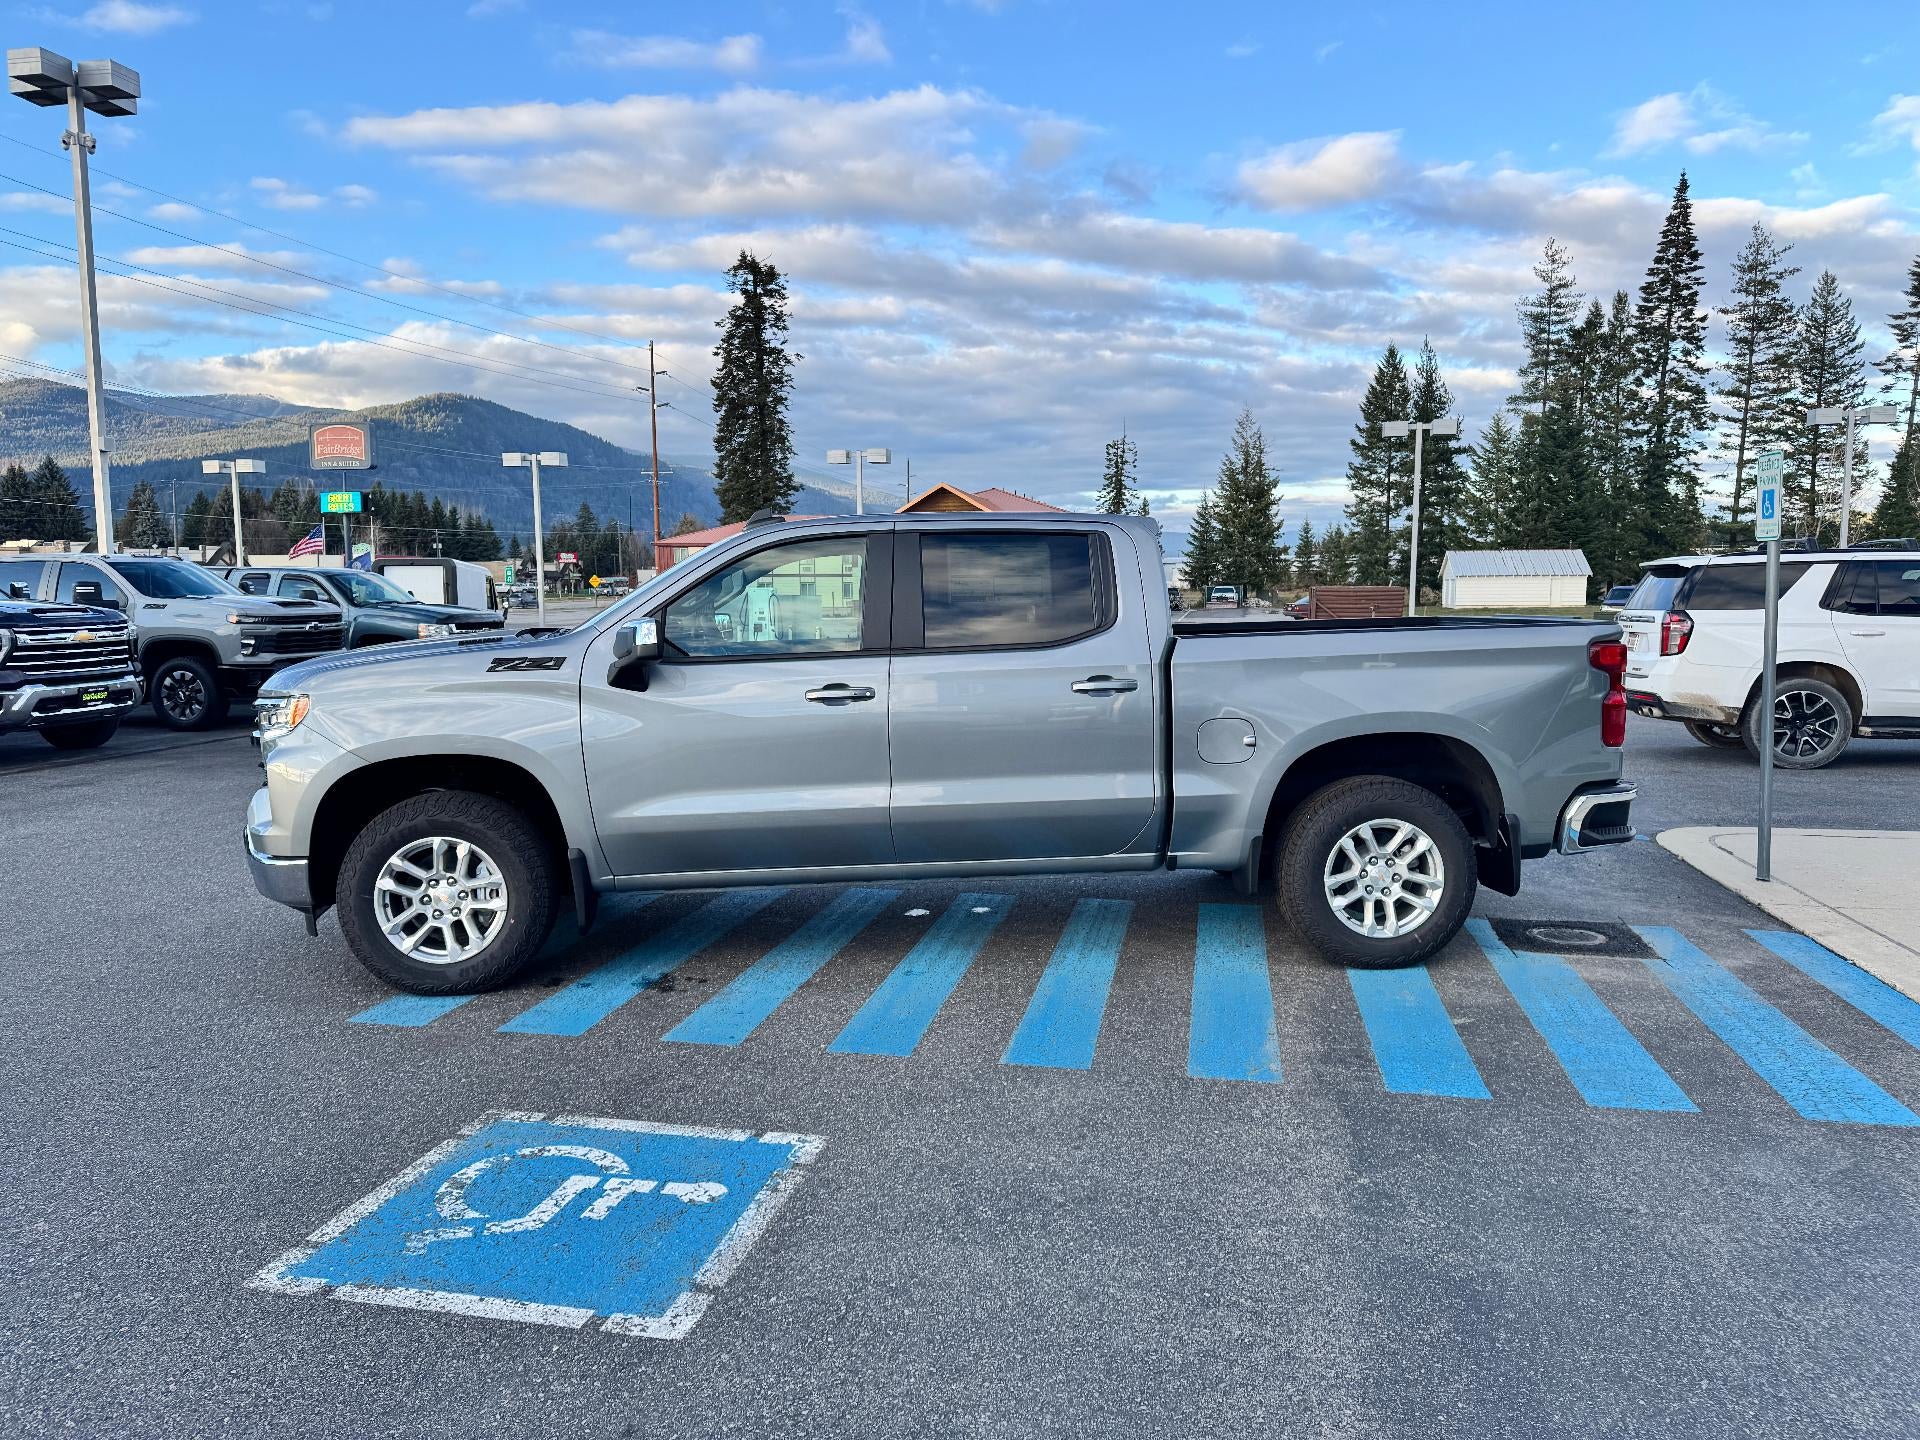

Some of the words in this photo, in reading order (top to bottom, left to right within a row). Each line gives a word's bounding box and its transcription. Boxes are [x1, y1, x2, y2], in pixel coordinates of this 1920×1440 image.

[317, 444, 361, 455] FairBridge
[328, 493, 352, 502] GREAT
[328, 502, 354, 512] RATES
[486, 656, 567, 672] Z71
